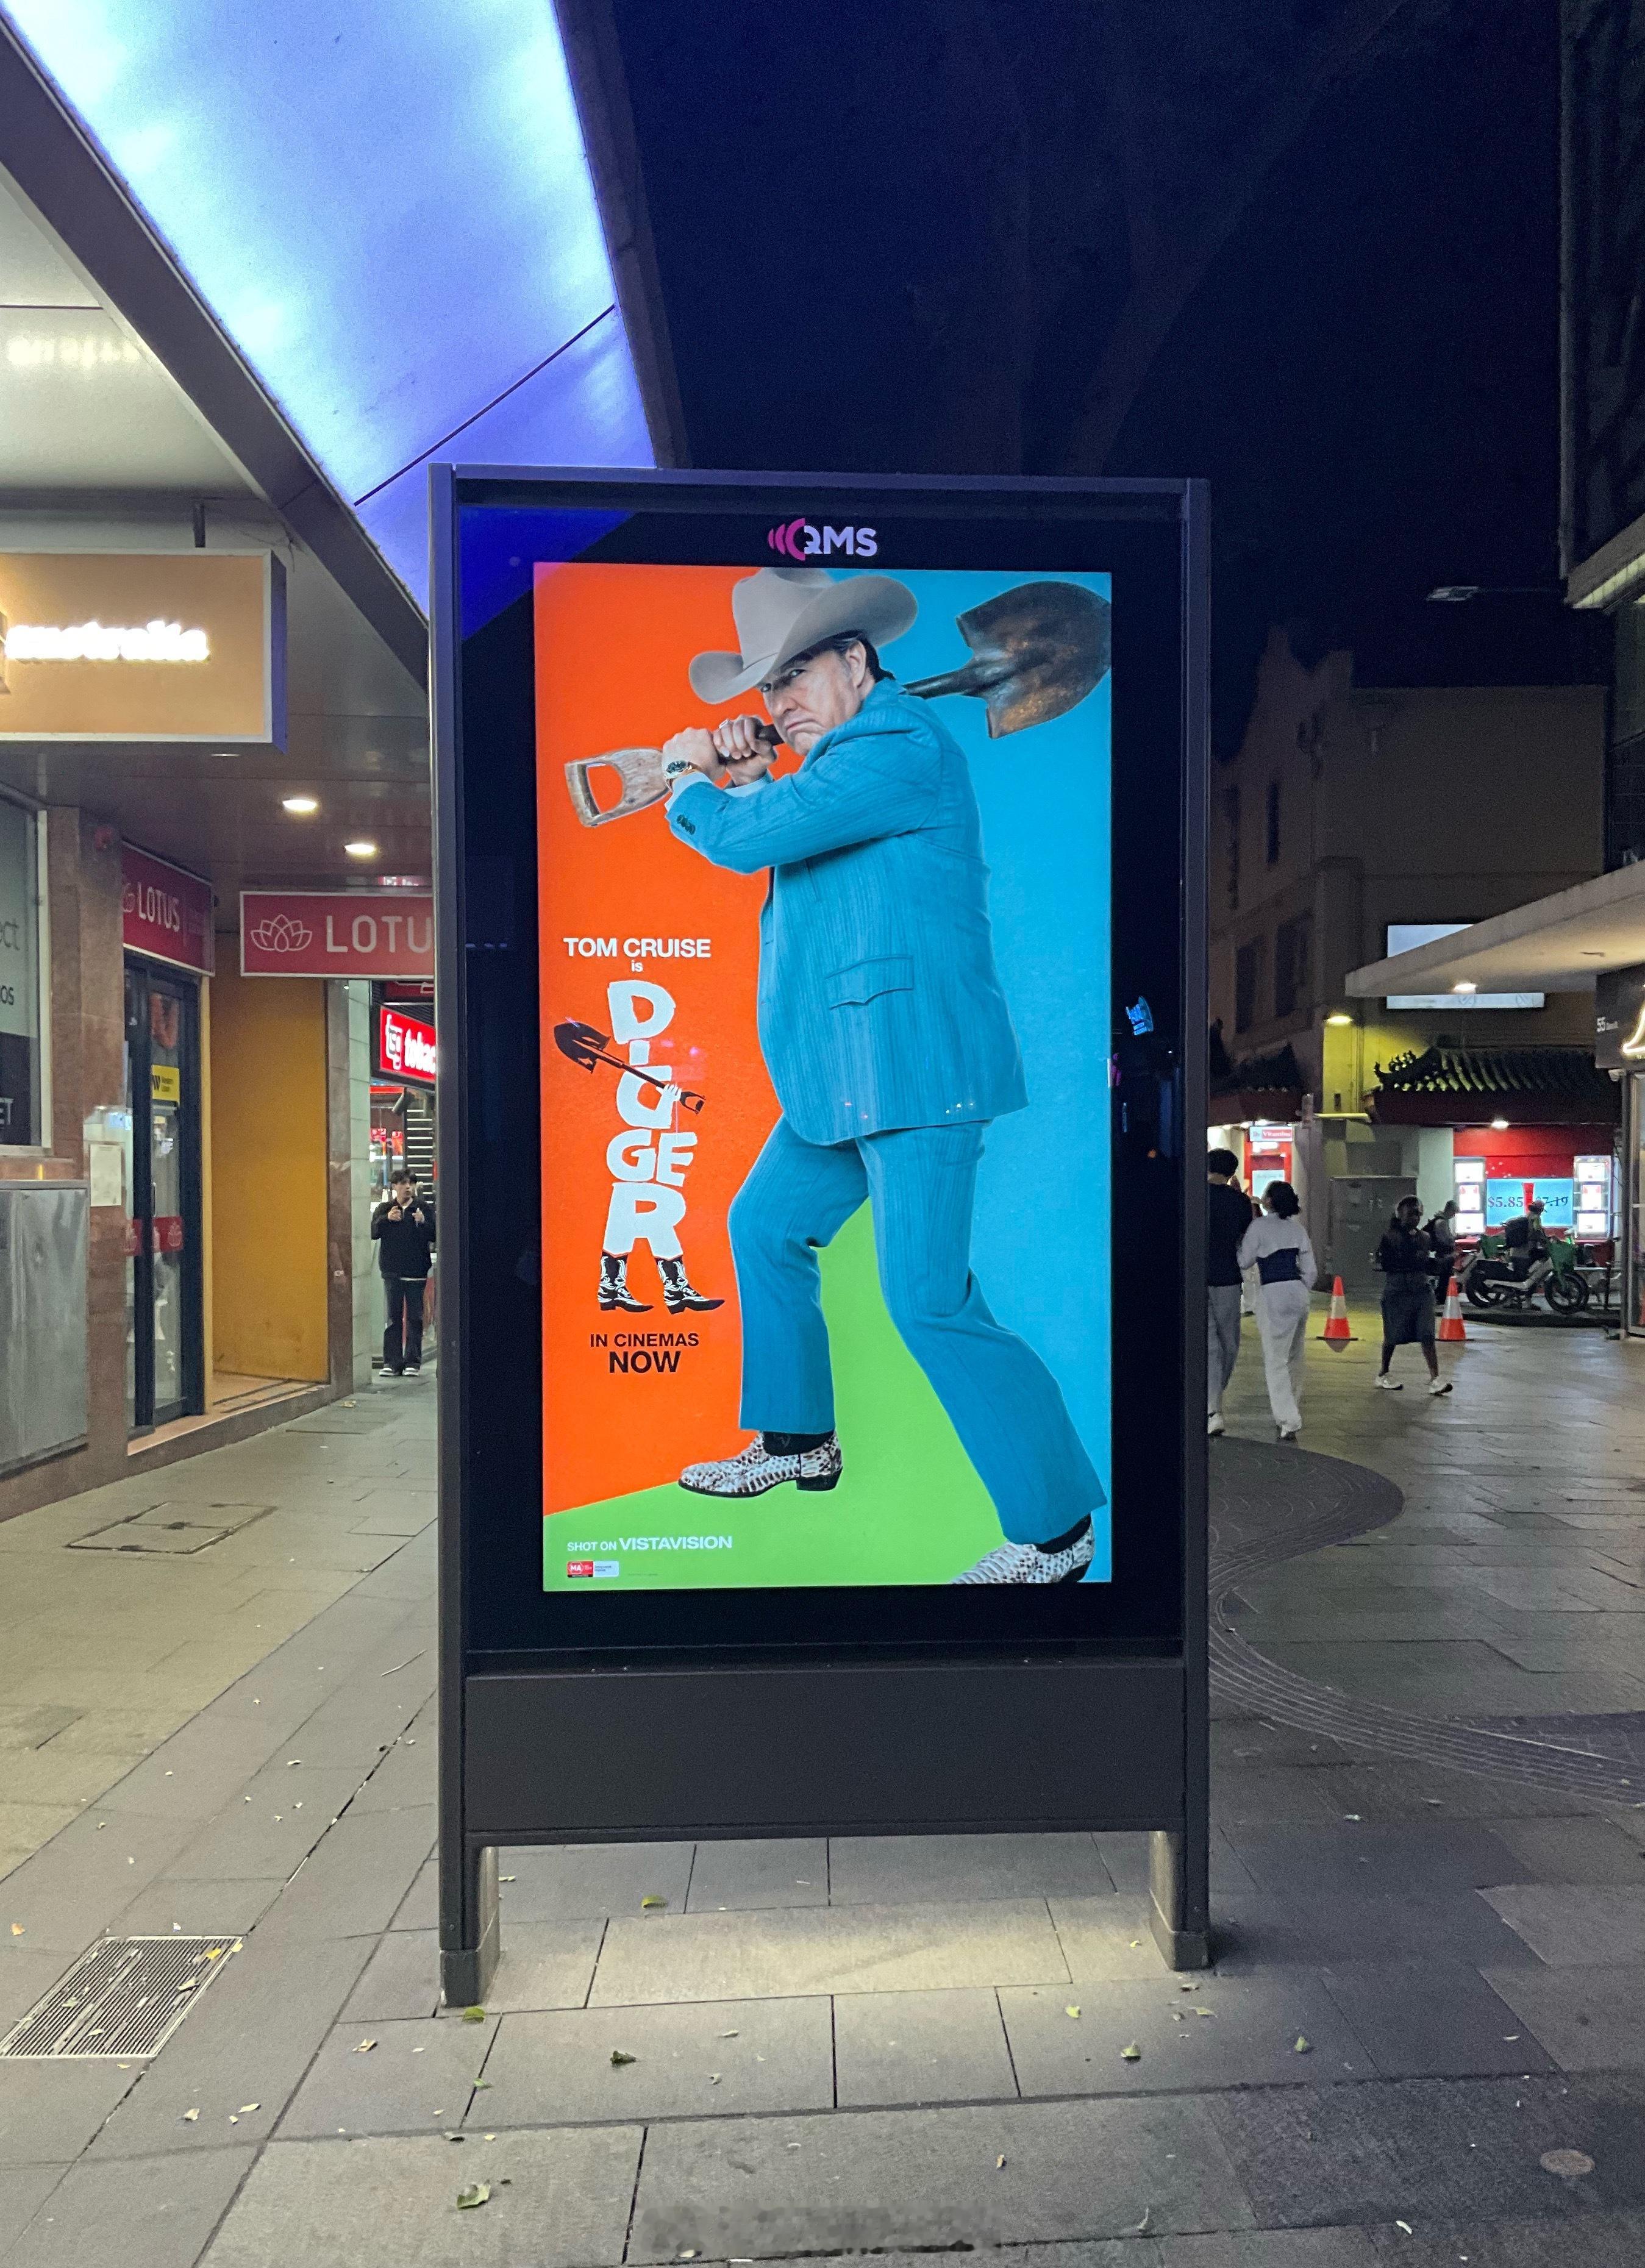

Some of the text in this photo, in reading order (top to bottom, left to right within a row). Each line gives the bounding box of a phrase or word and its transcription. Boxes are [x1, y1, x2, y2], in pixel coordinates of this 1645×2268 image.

[785, 518, 878, 562] QMS
[137, 882, 180, 932] LOTUS
[326, 915, 432, 954] LOTU
[563, 938, 712, 958] TOM CRUISE
[631, 960, 643, 972] is
[1487, 1196, 1523, 1208] $5.85
[590, 1333, 699, 1347] IN CINEMAS
[610, 1350, 681, 1373] NOW
[567, 1536, 732, 1552] SHOT ON VISTAVISION
